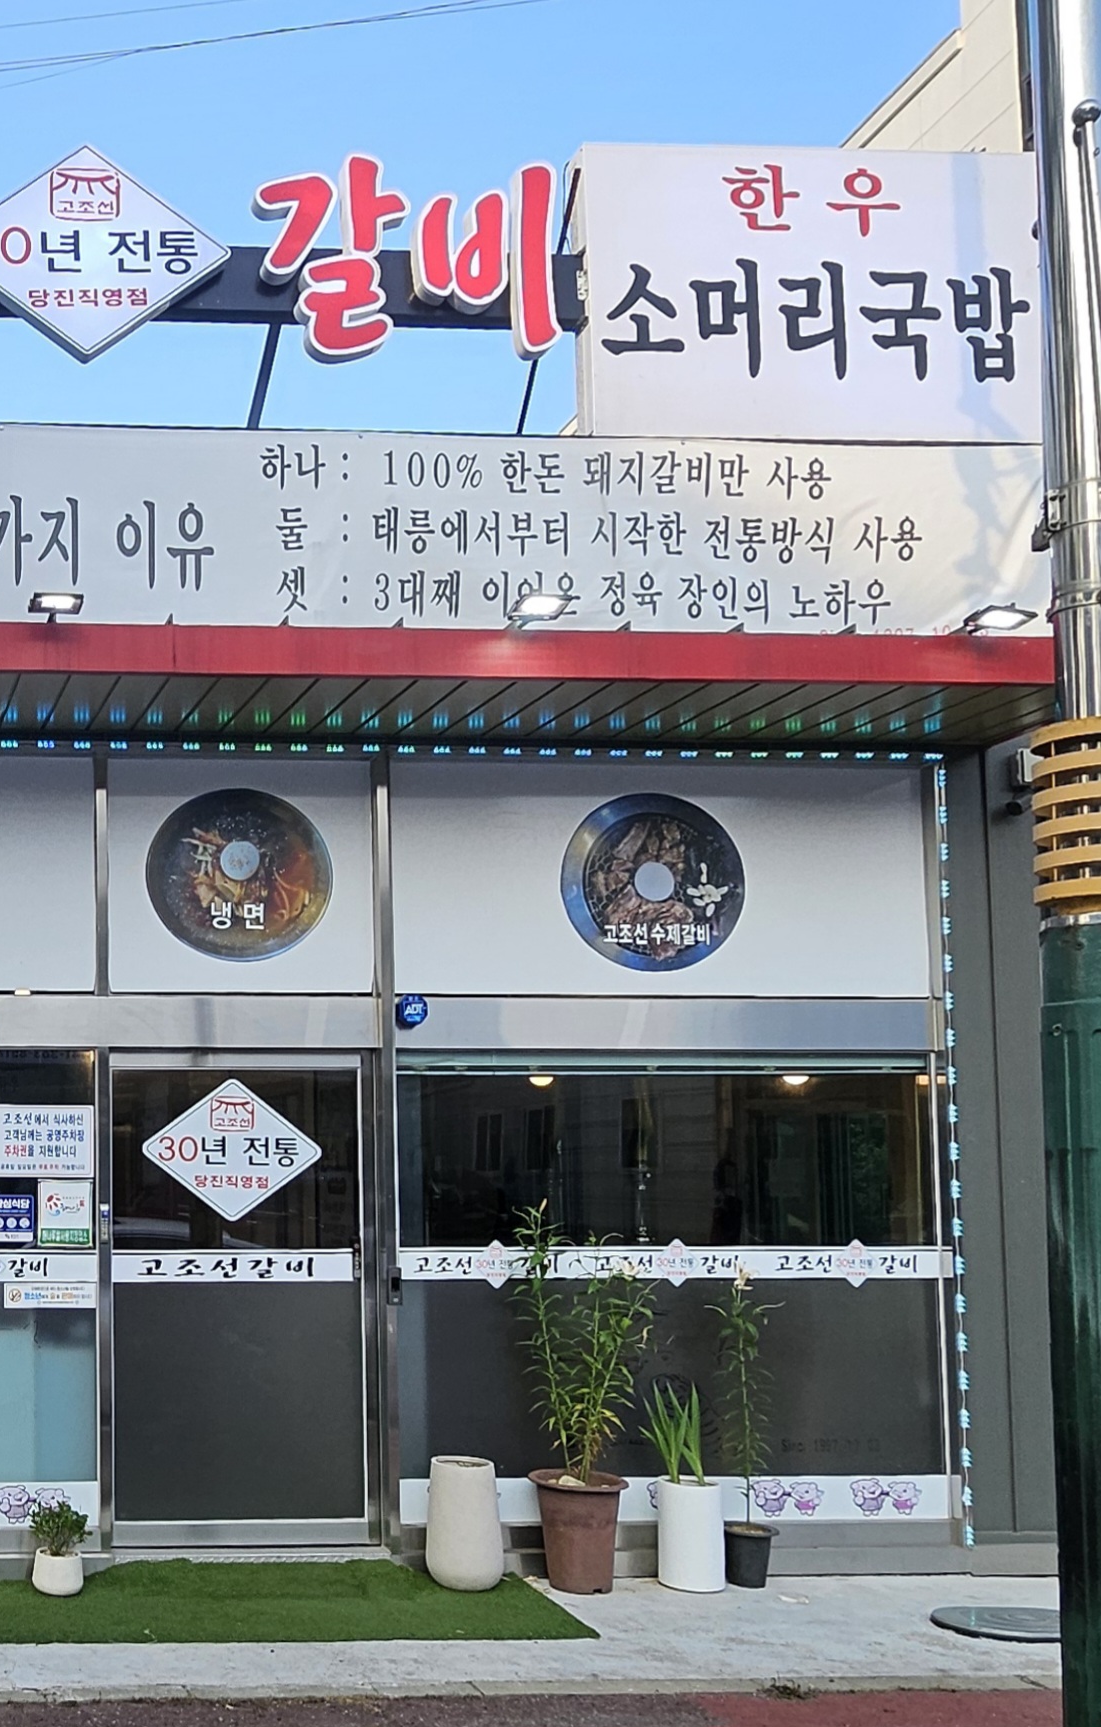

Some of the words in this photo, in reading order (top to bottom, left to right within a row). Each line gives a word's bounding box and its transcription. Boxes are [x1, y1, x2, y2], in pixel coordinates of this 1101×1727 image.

[57, 200, 114, 215] 고조선
[722, 163, 901, 237] 한우
[108, 230, 198, 275] 전통
[252, 155, 561, 364] 갈비
[28, 288, 148, 308] 당진직영점
[601, 258, 1031, 383] 소머리국밥
[384, 451, 483, 489] 100%
[500, 450, 565, 493] 한돈
[583, 450, 749, 497] 돼지갈비만
[766, 456, 832, 501] 사용
[116, 500, 214, 591] 이유
[276, 507, 308, 550] 둘
[372, 507, 569, 557] 태릉에서부터
[592, 511, 687, 557] 시작한
[704, 516, 836, 565] 전통방식
[854, 516, 923, 565] 사용
[276, 566, 308, 612] 셋
[374, 570, 462, 618] 3대째
[600, 571, 662, 617] 정육
[678, 573, 770, 624] 장인의
[790, 578, 891, 625] 노하우
[211, 902, 265, 929] 냉면
[404, 1004, 423, 1015] ADT
[214, 1118, 250, 1127] 고조선
[39, 1145, 77, 1157] 지원합니다
[158, 1136, 227, 1165] 30년
[243, 1137, 299, 1167] 전통
[194, 1175, 269, 1189] 당진직영점
[8, 1257, 49, 1278] 갈비
[414, 1256, 471, 1275] 고조선
[597, 1254, 653, 1274] 고선
[775, 1255, 832, 1274] 고조선
[879, 1255, 917, 1274] 갈비
